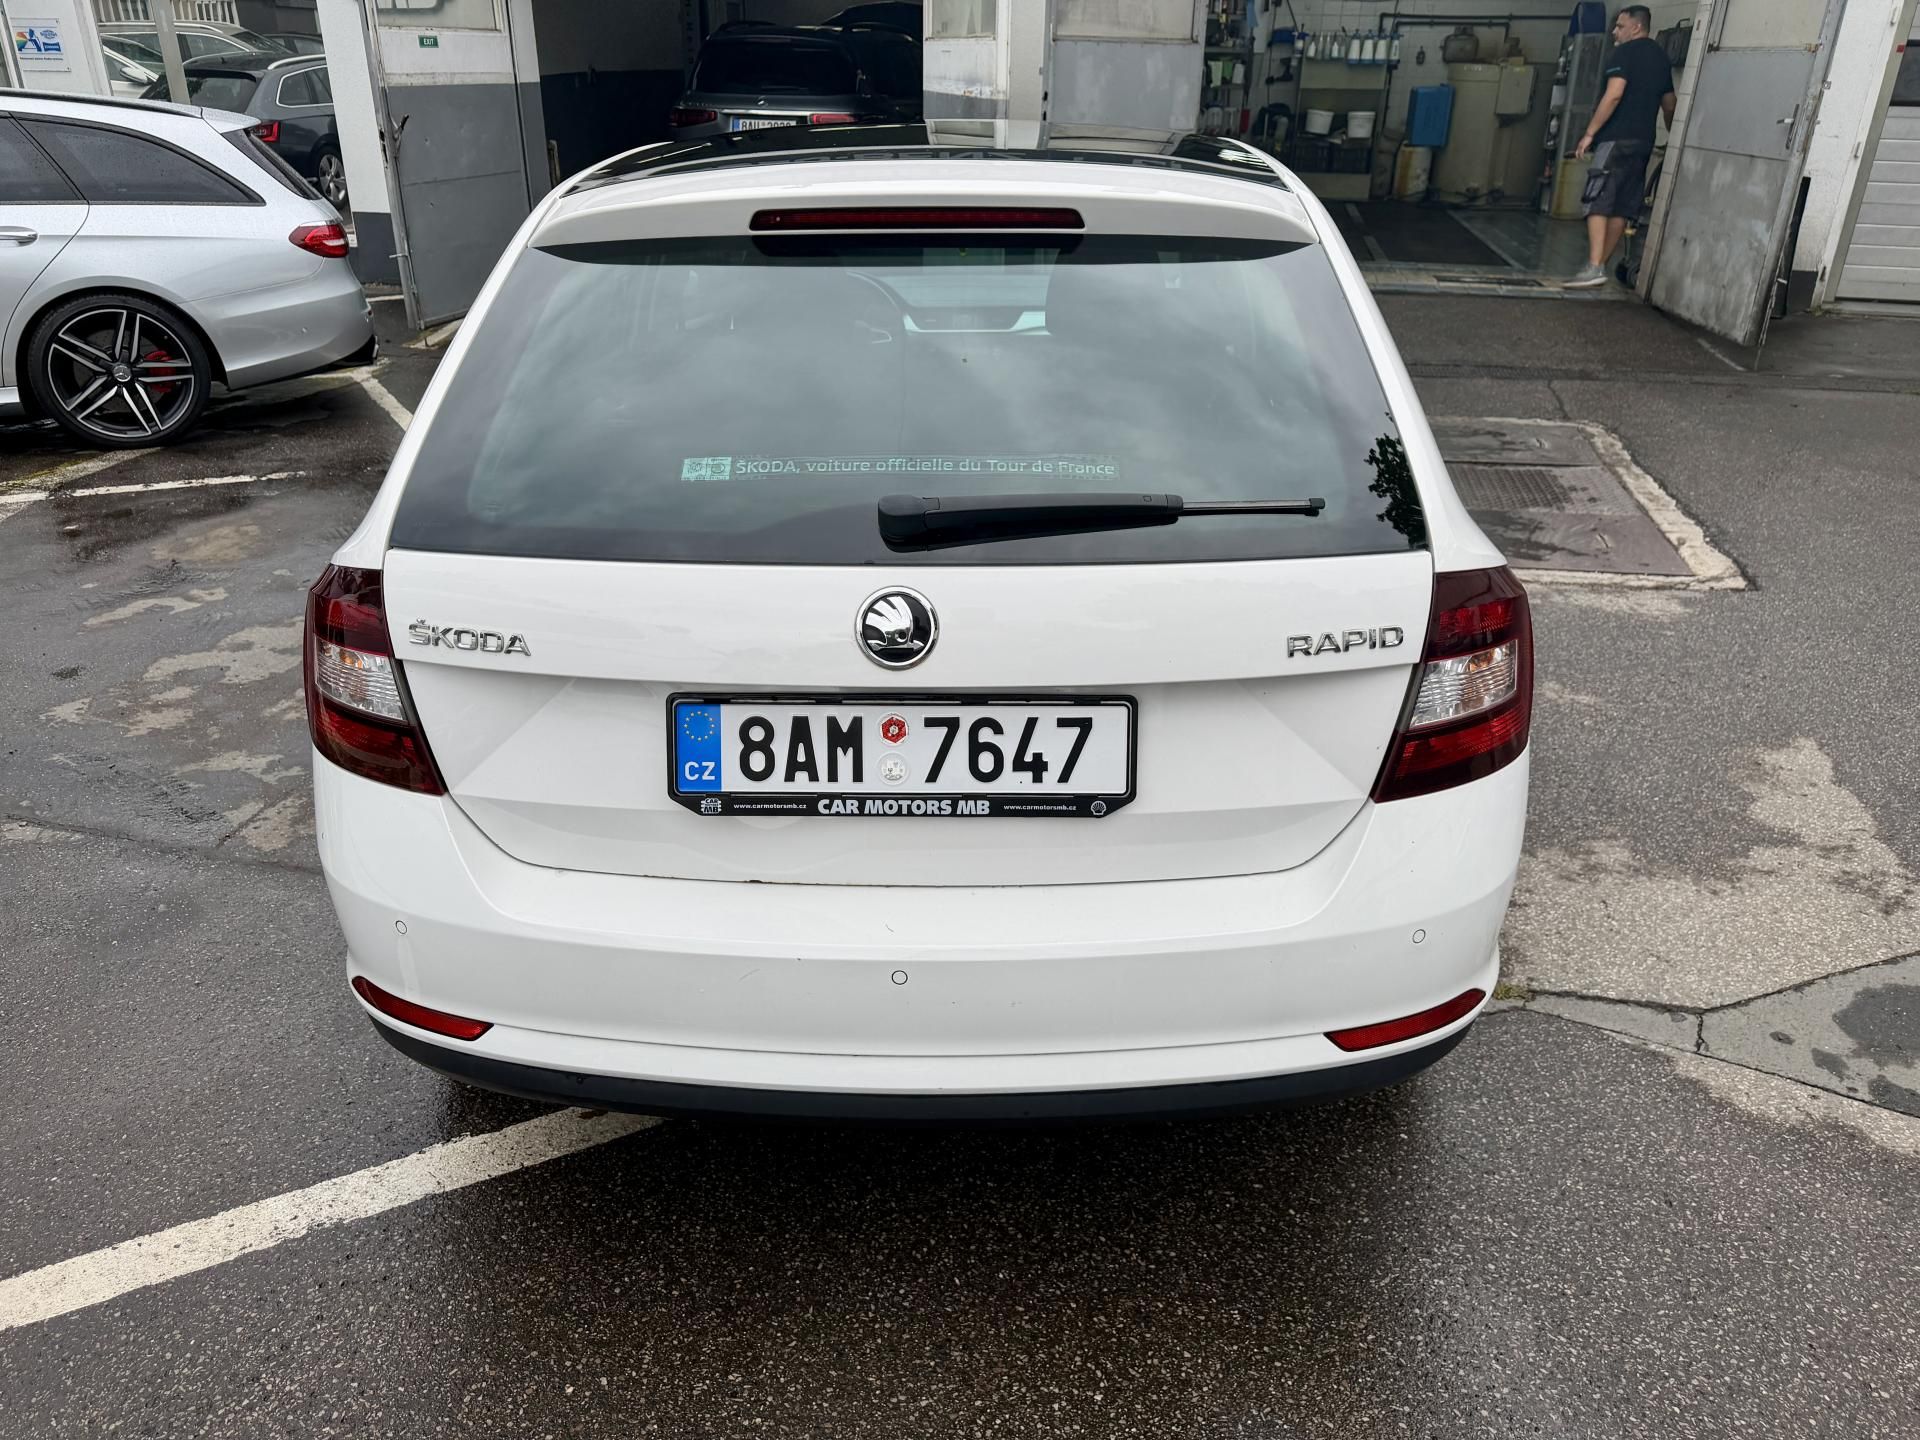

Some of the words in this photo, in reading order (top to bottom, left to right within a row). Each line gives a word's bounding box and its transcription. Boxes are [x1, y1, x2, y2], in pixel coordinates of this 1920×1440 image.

[735, 457, 800, 474] ŠKODA,
[806, 459, 870, 472] voiture
[876, 458, 954, 472] officielle
[959, 459, 981, 472] du
[986, 460, 1027, 472] Tour
[1032, 460, 1053, 473] de
[1058, 462, 1115, 474] France
[408, 616, 531, 656] ŠKODA
[1287, 626, 1404, 658] RAPID
[738, 715, 864, 783] 8AM
[923, 716, 1093, 783] 7647
[684, 761, 716, 781] CZ
[817, 799, 859, 815] CAR
[863, 799, 952, 815] MOTORS
[956, 799, 990, 815] MB
